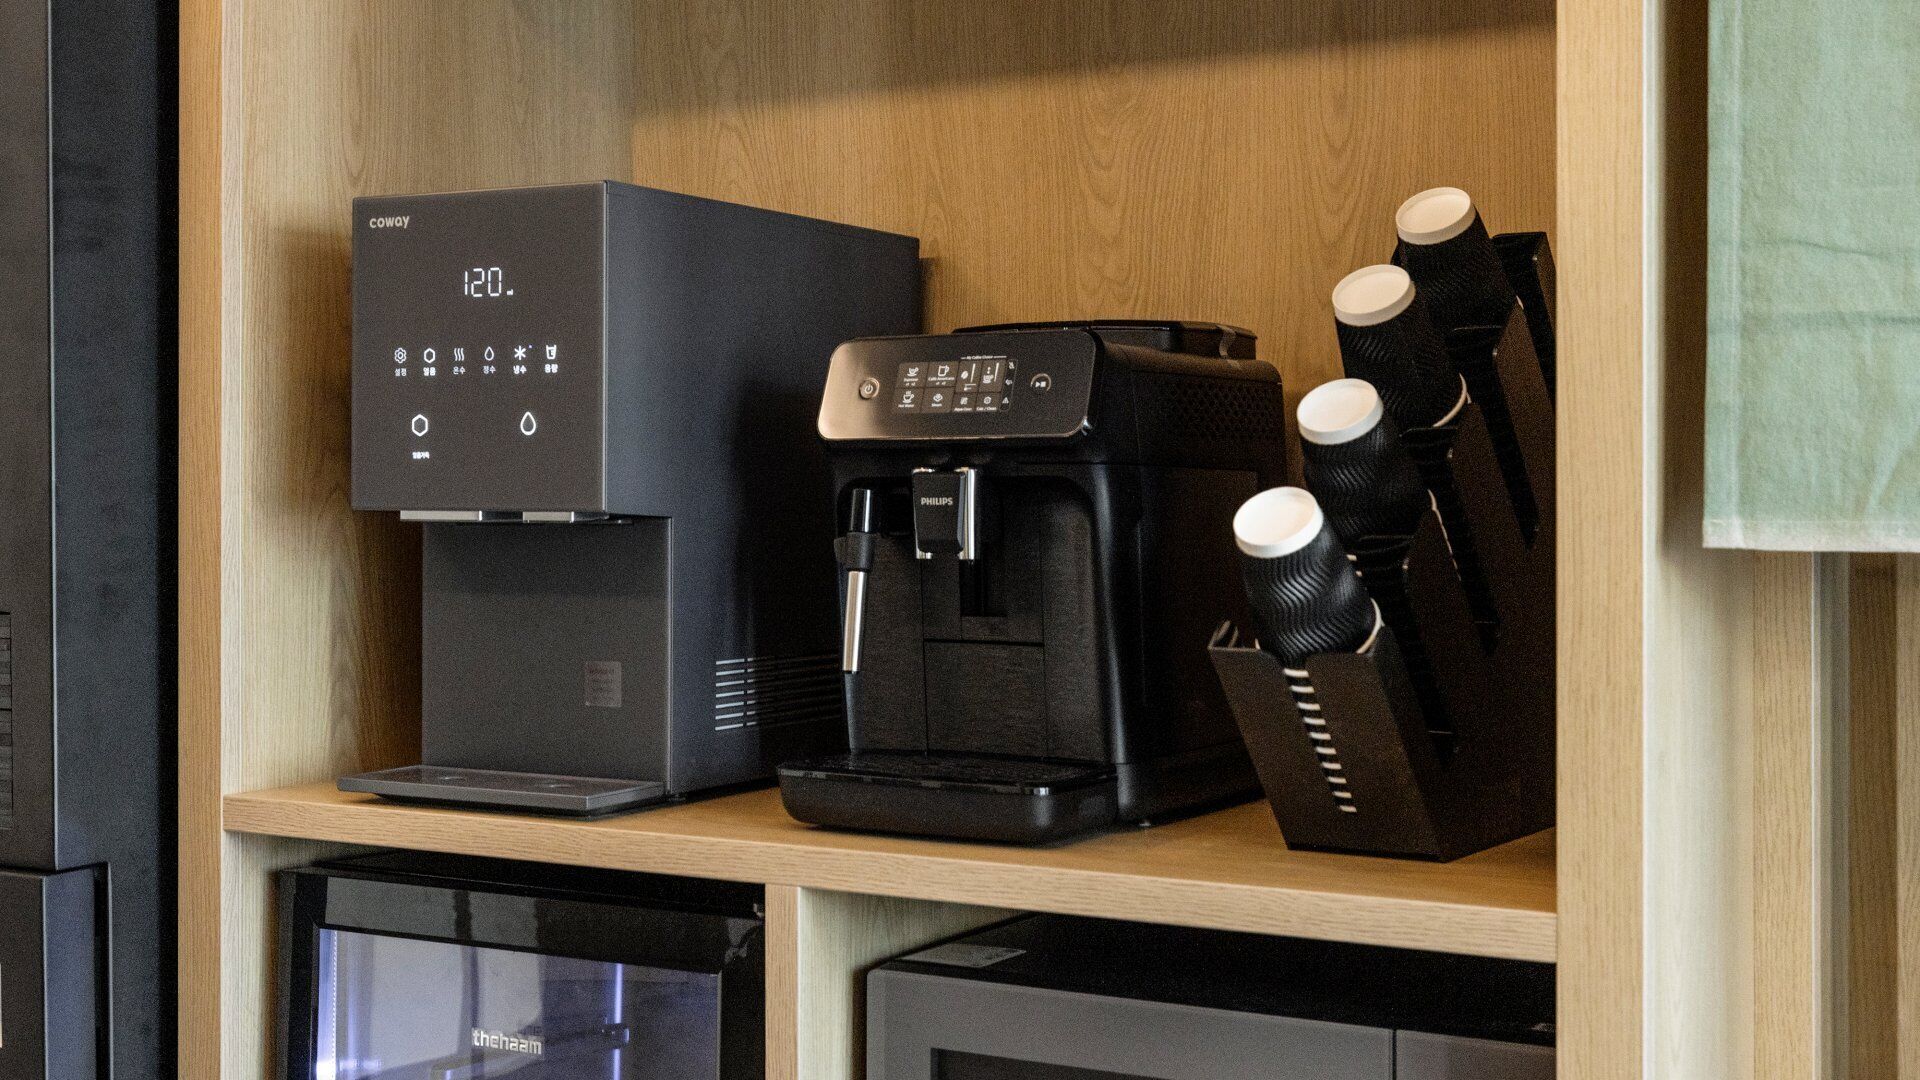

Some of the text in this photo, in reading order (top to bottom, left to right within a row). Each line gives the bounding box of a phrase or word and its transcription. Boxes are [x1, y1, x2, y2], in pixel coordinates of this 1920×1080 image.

[369, 215, 410, 229] coway
[464, 267, 502, 297] 120
[920, 497, 953, 506] PHILIPS
[472, 1027, 542, 1054] thehaam
